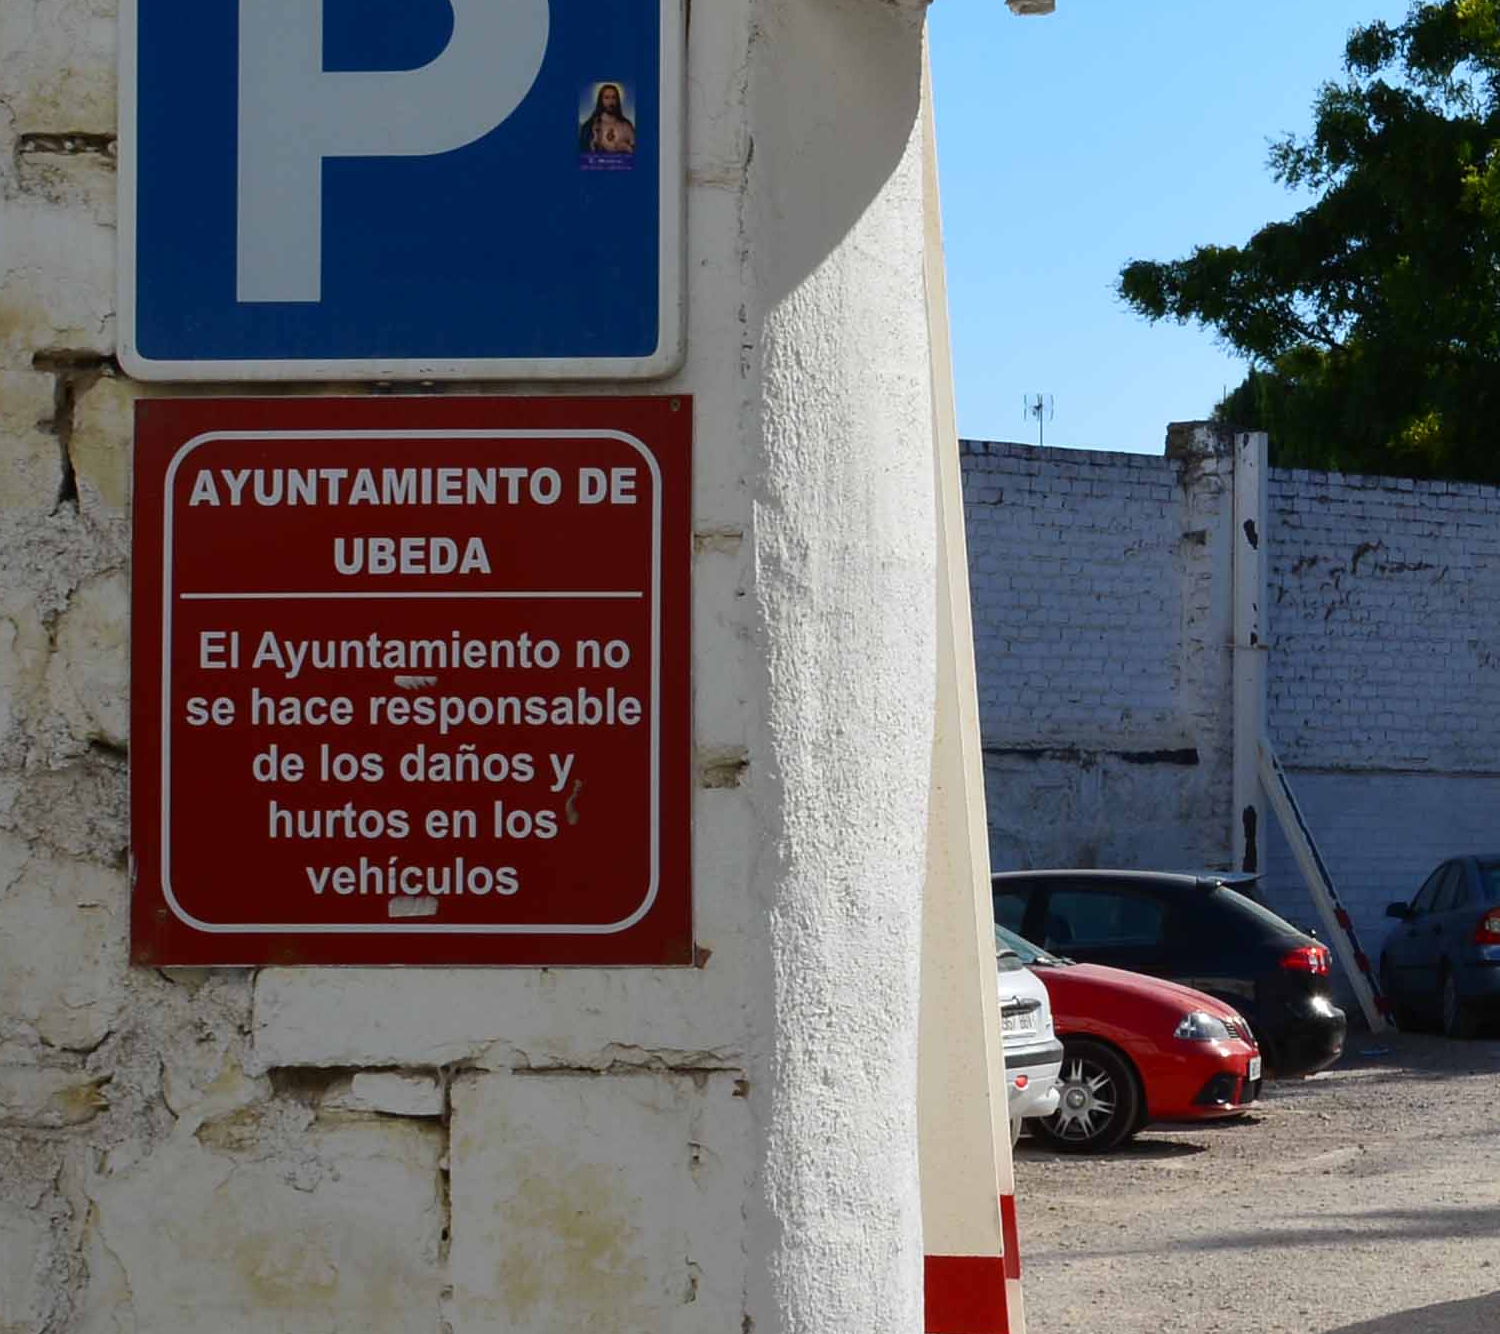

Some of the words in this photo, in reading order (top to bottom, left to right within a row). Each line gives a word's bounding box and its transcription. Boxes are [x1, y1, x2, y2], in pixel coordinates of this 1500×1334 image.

[189, 467, 561, 506] AYUNTAMIENTO
[579, 468, 636, 504] DE
[335, 537, 491, 574] UBEDA
[201, 632, 238, 668] El
[252, 631, 560, 678] Ayuntamiento
[577, 640, 630, 668] no
[187, 697, 234, 725] se
[252, 688, 353, 725] hace
[370, 683, 641, 734] responsable
[253, 744, 304, 781] de
[321, 744, 384, 781] los
[400, 744, 534, 781] daños
[550, 754, 574, 791] y
[270, 801, 409, 838] hurtos
[426, 810, 476, 838] en
[495, 801, 557, 838] los
[306, 857, 518, 894] vehículos
